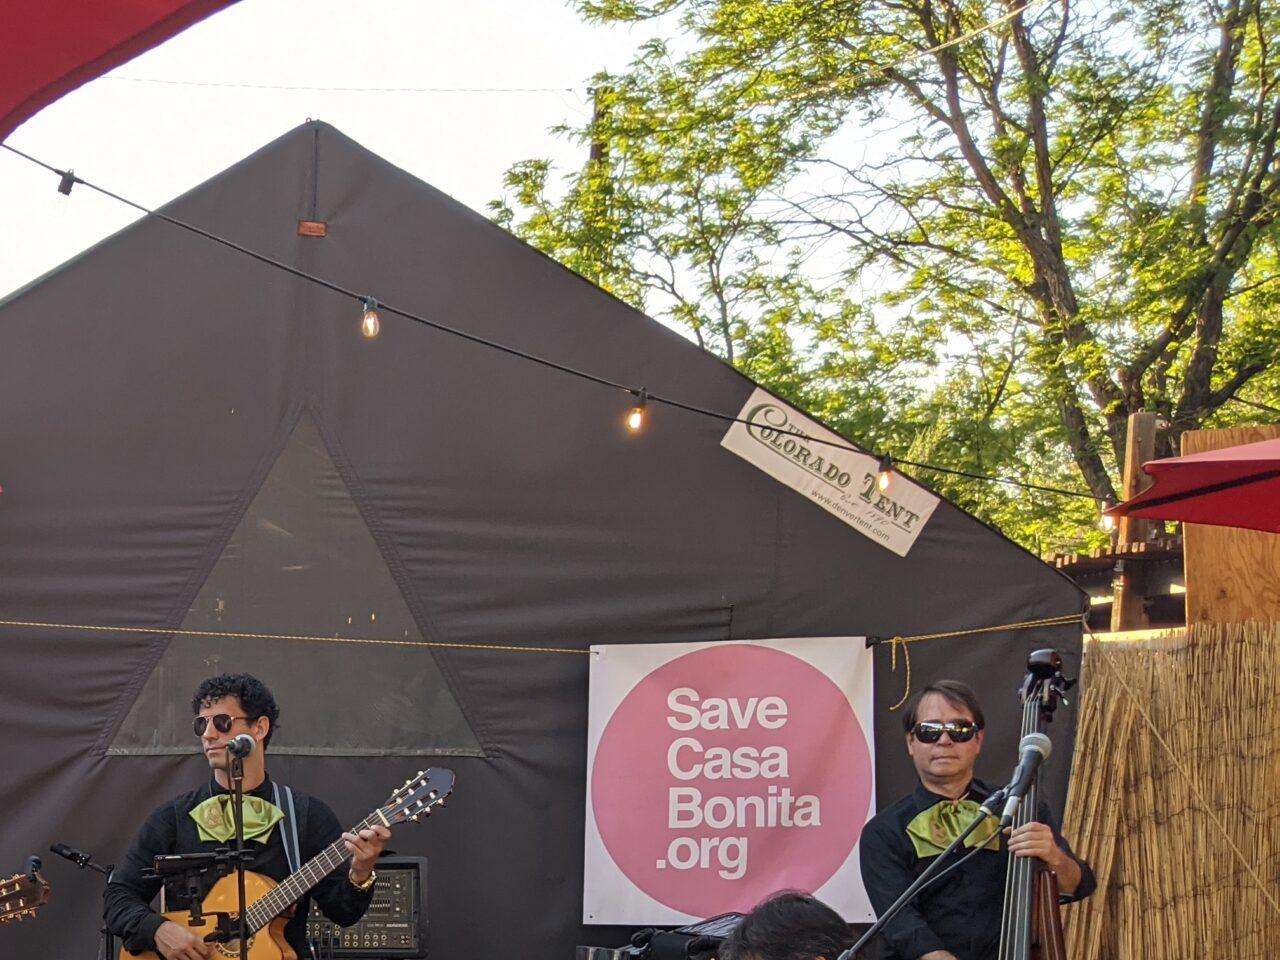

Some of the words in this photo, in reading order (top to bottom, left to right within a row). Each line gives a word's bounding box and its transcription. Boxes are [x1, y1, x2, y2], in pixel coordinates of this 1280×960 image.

[746, 403, 851, 488] COLORADO
[859, 472, 920, 529] TENT
[811, 489, 891, 541] www.denvertent.com
[666, 687, 788, 730] Save
[667, 737, 789, 780] Casa
[668, 785, 822, 829] Bonita
[656, 835, 748, 880] .org
